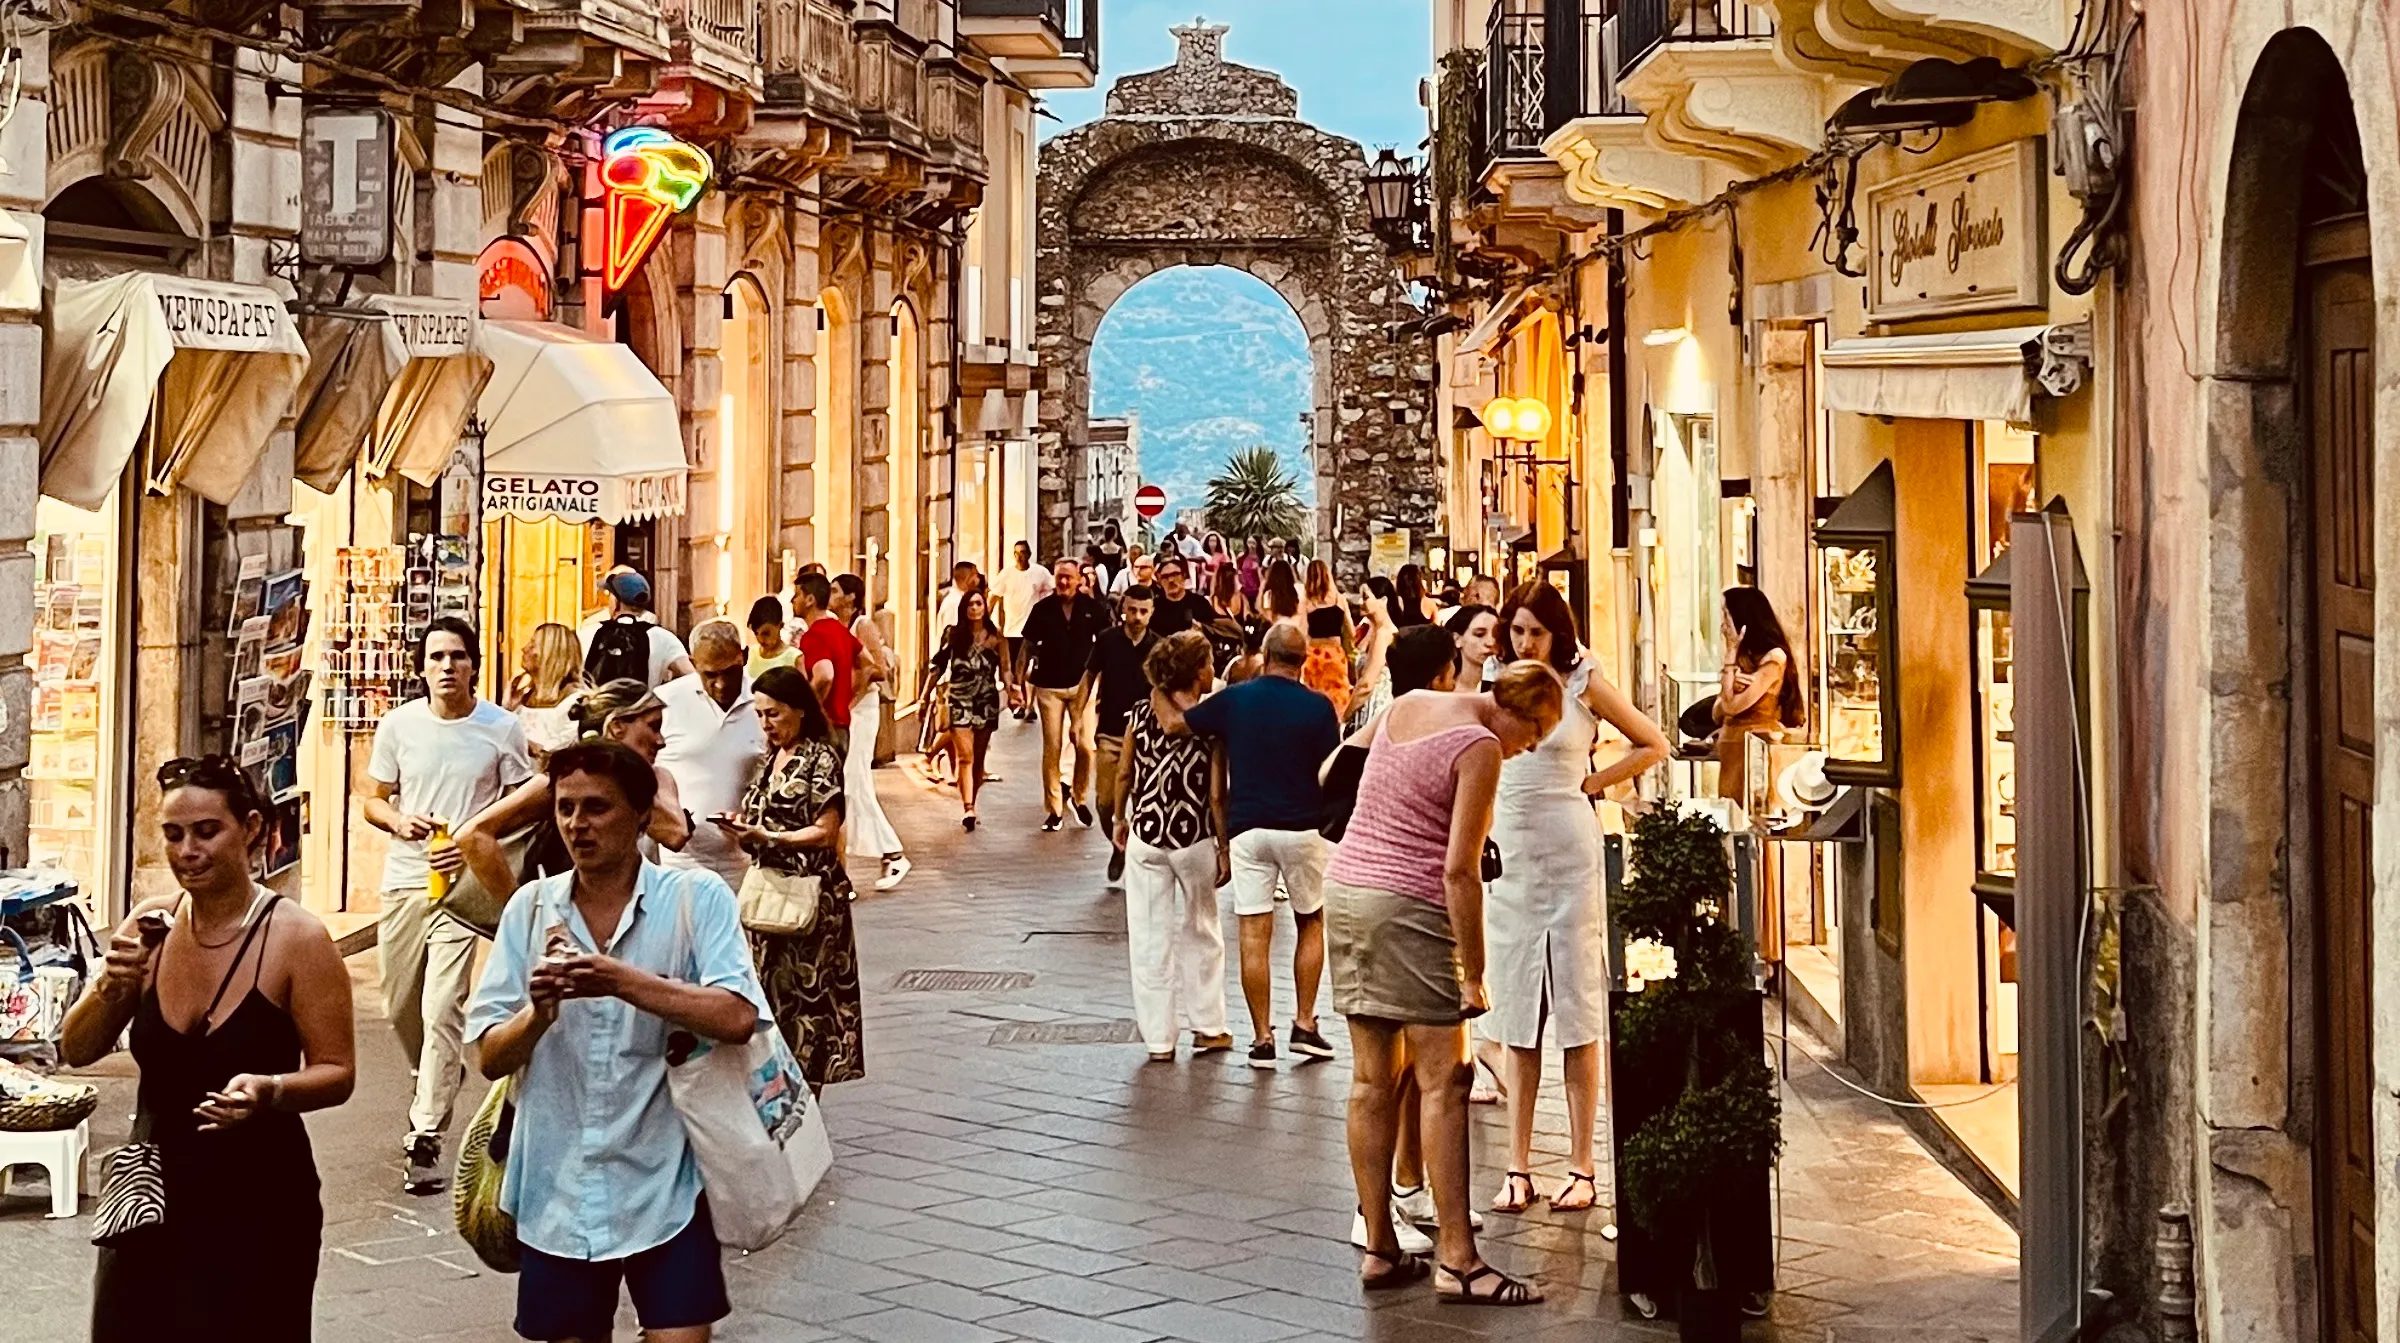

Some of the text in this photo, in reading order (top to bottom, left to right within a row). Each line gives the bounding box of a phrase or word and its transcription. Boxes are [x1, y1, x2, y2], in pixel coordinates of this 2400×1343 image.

[314, 116, 377, 213] T
[487, 477, 600, 496] GELATO
[486, 495, 600, 513] ARTIGIANALE
